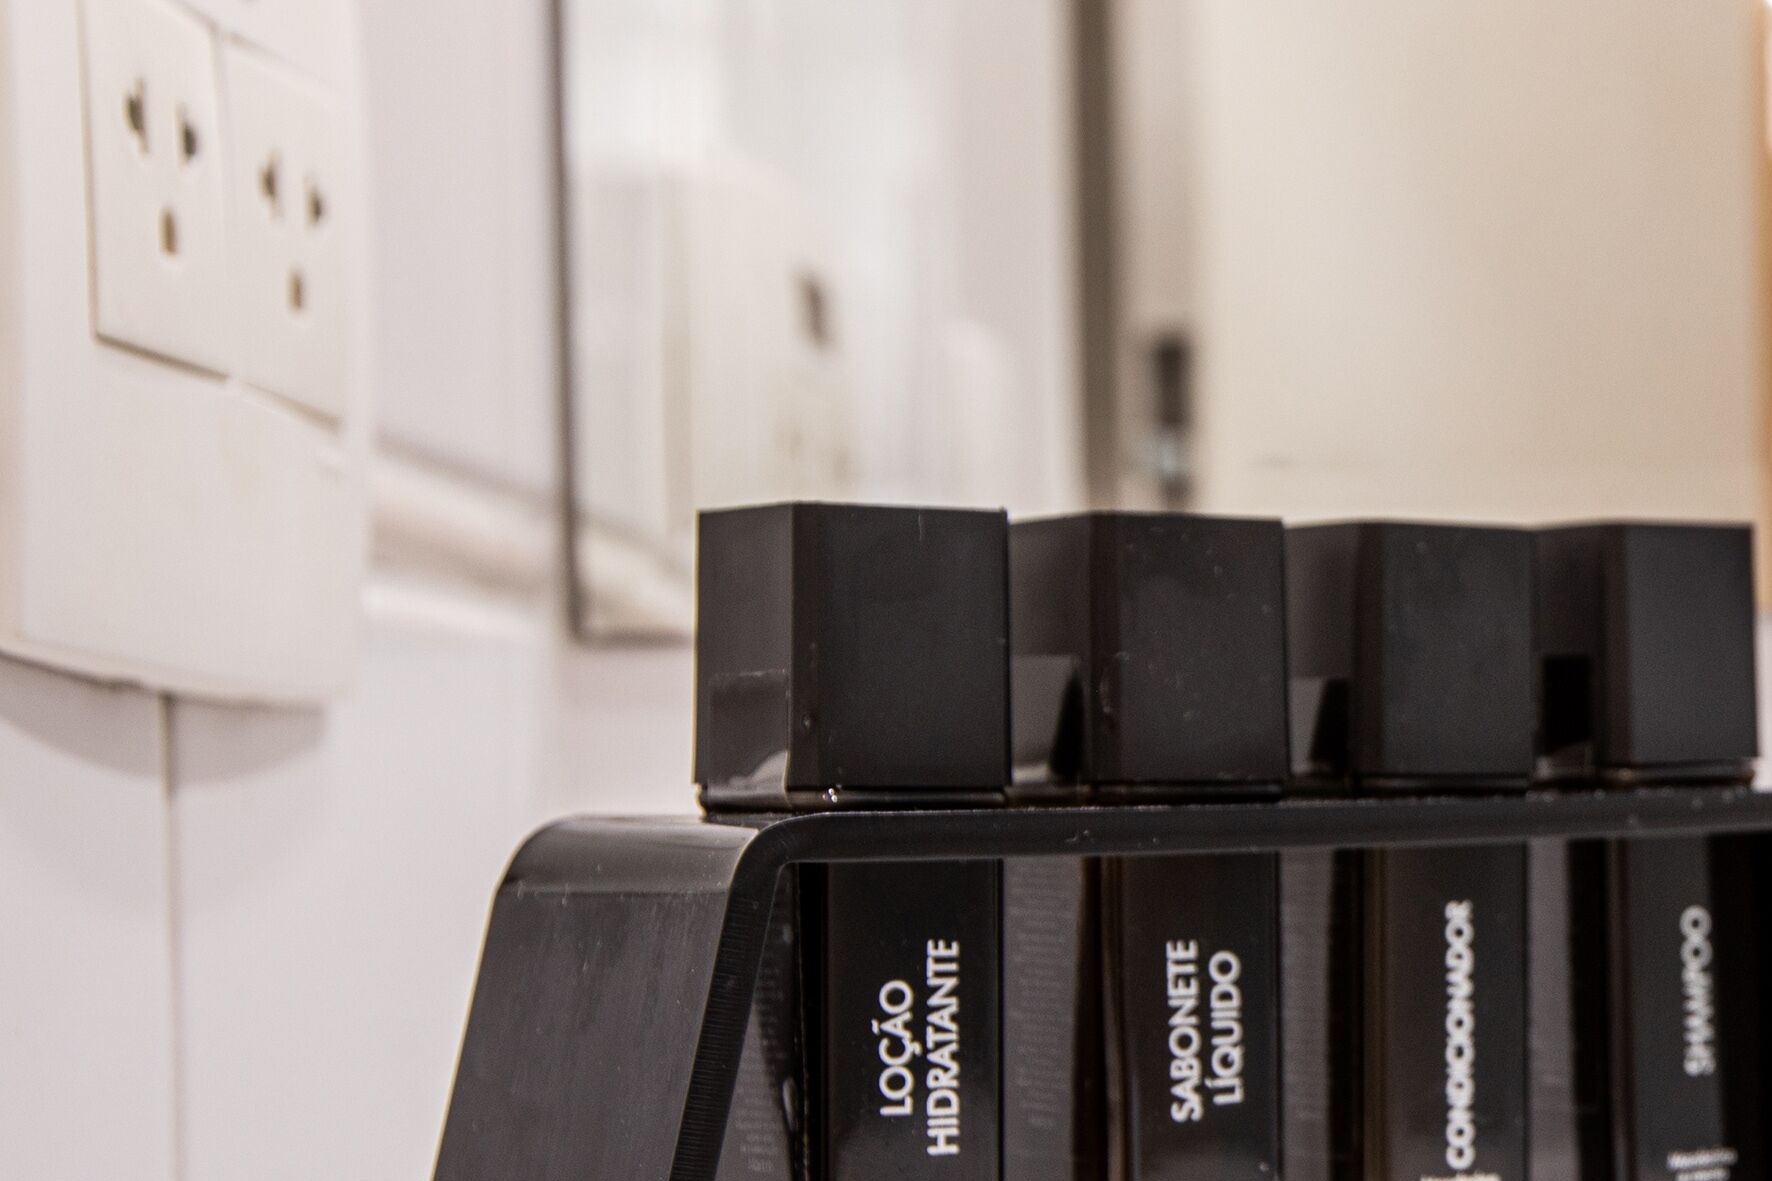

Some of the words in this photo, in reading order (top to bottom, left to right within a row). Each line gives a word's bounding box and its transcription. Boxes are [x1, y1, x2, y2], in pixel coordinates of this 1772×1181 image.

[872, 980, 922, 1117] LOÇÃO
[926, 939, 961, 1156] HIDRATANTE
[1166, 940, 1203, 1123] SABONETE
[1205, 950, 1244, 1105] LÍQUIDO
[1446, 901, 1476, 1171] CONDICIONADOR
[1679, 905, 1716, 1076] SHAMPOO
